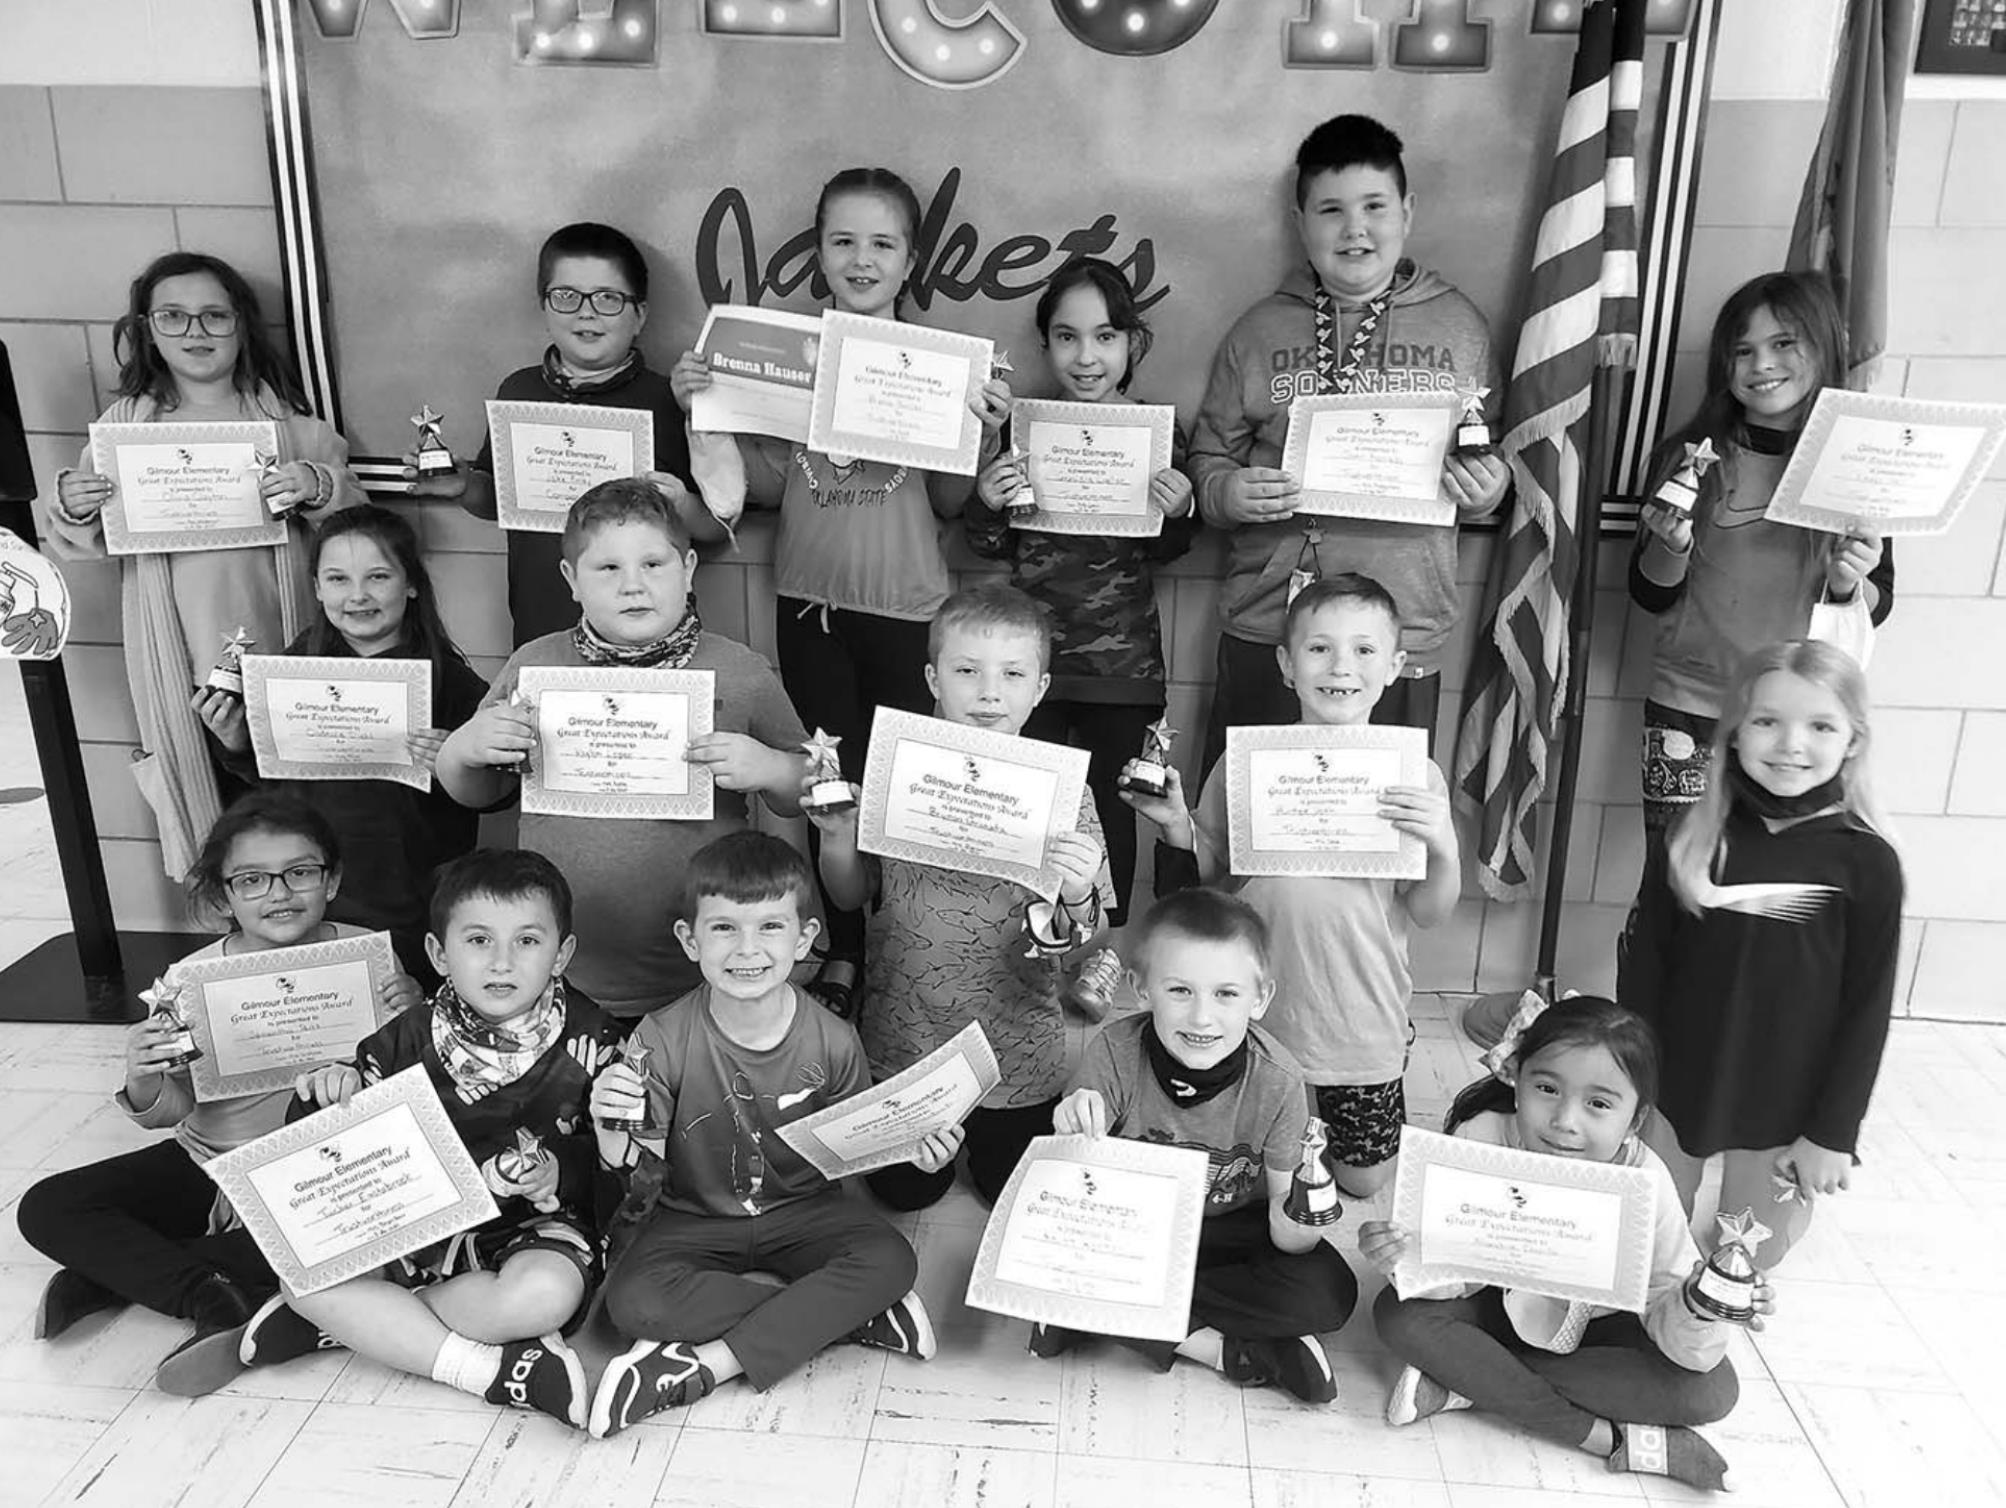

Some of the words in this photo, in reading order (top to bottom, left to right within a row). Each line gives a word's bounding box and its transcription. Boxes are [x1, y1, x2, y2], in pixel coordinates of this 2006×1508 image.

[695, 167, 1171, 312] Jakets
[713, 352, 762, 375] Brenna
[1271, 343, 1458, 373] OKHOMA
[1270, 369, 1456, 404] SONERS
[568, 717, 603, 727] Gilmour
[606, 718, 657, 731] Elementary
[922, 774, 962, 791] Gilmour
[963, 784, 1020, 806] Elementary
[231, 1013, 259, 1025] Great
[320, 996, 354, 1011] Award
[241, 1000, 281, 1011] Gilmour
[283, 992, 339, 1006] Elementary
[293, 1172, 334, 1192] Gilmour
[334, 1146, 393, 1176] Elementary
[1460, 1203, 1506, 1219] Gilmour
[1509, 1210, 1576, 1230] Elementary
